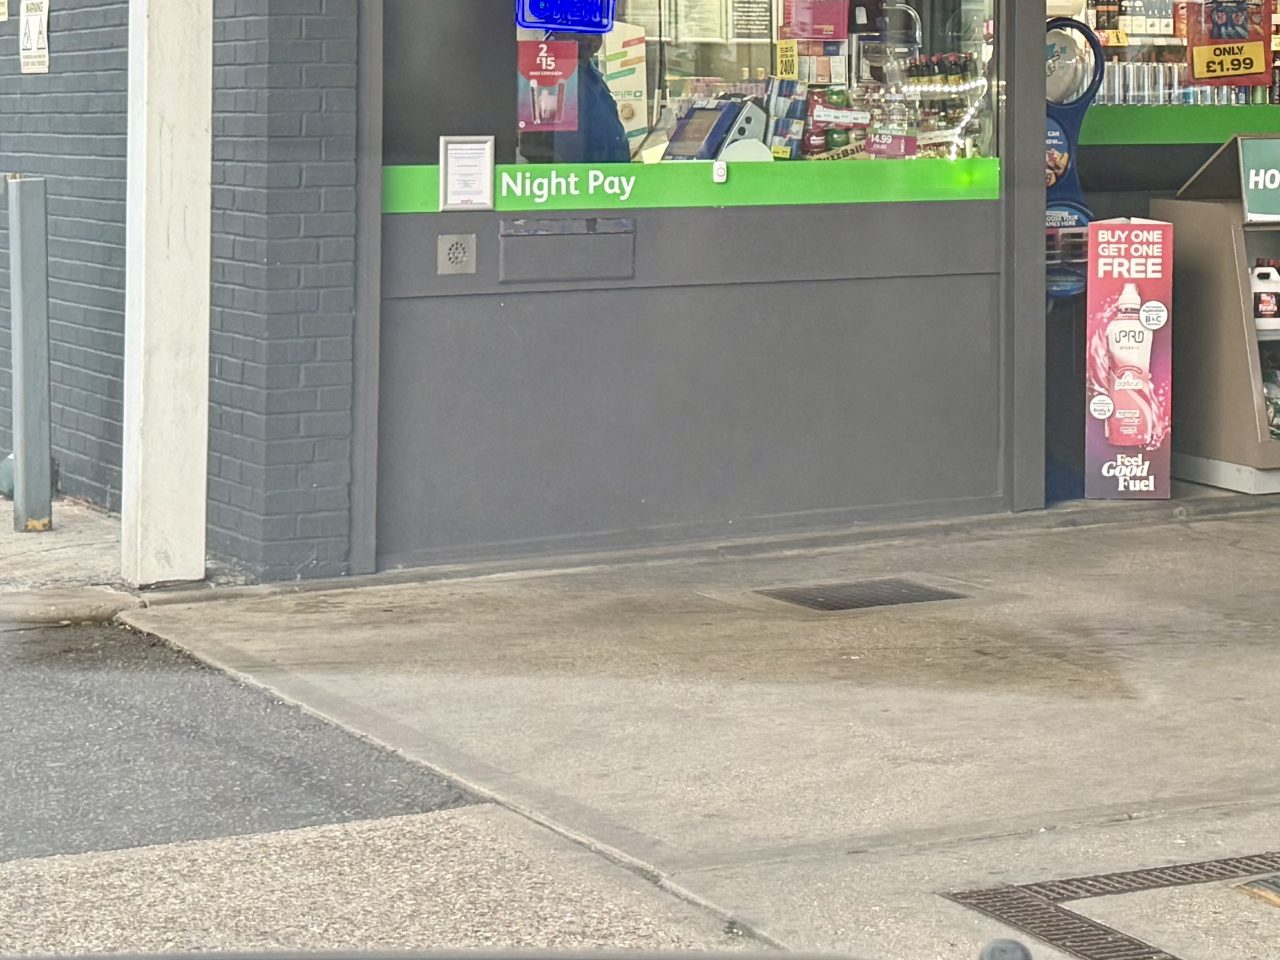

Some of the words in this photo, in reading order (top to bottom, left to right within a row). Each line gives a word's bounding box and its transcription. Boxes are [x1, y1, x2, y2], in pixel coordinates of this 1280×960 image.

[539, 44, 547, 56] 2
[1213, 46, 1244, 57] ONLY
[536, 57, 555, 69] £15
[1206, 57, 1254, 73] £1.99
[501, 171, 579, 202] Night
[588, 170, 636, 201] Pay
[1098, 230, 1128, 242] BUY
[1131, 230, 1162, 242] ONE
[1098, 244, 1128, 256] GET
[1131, 244, 1162, 256] ONE
[1098, 257, 1162, 278] FREE
[1117, 454, 1142, 466] Feel
[1101, 460, 1149, 477] Good
[1118, 475, 1155, 491] Fuel
